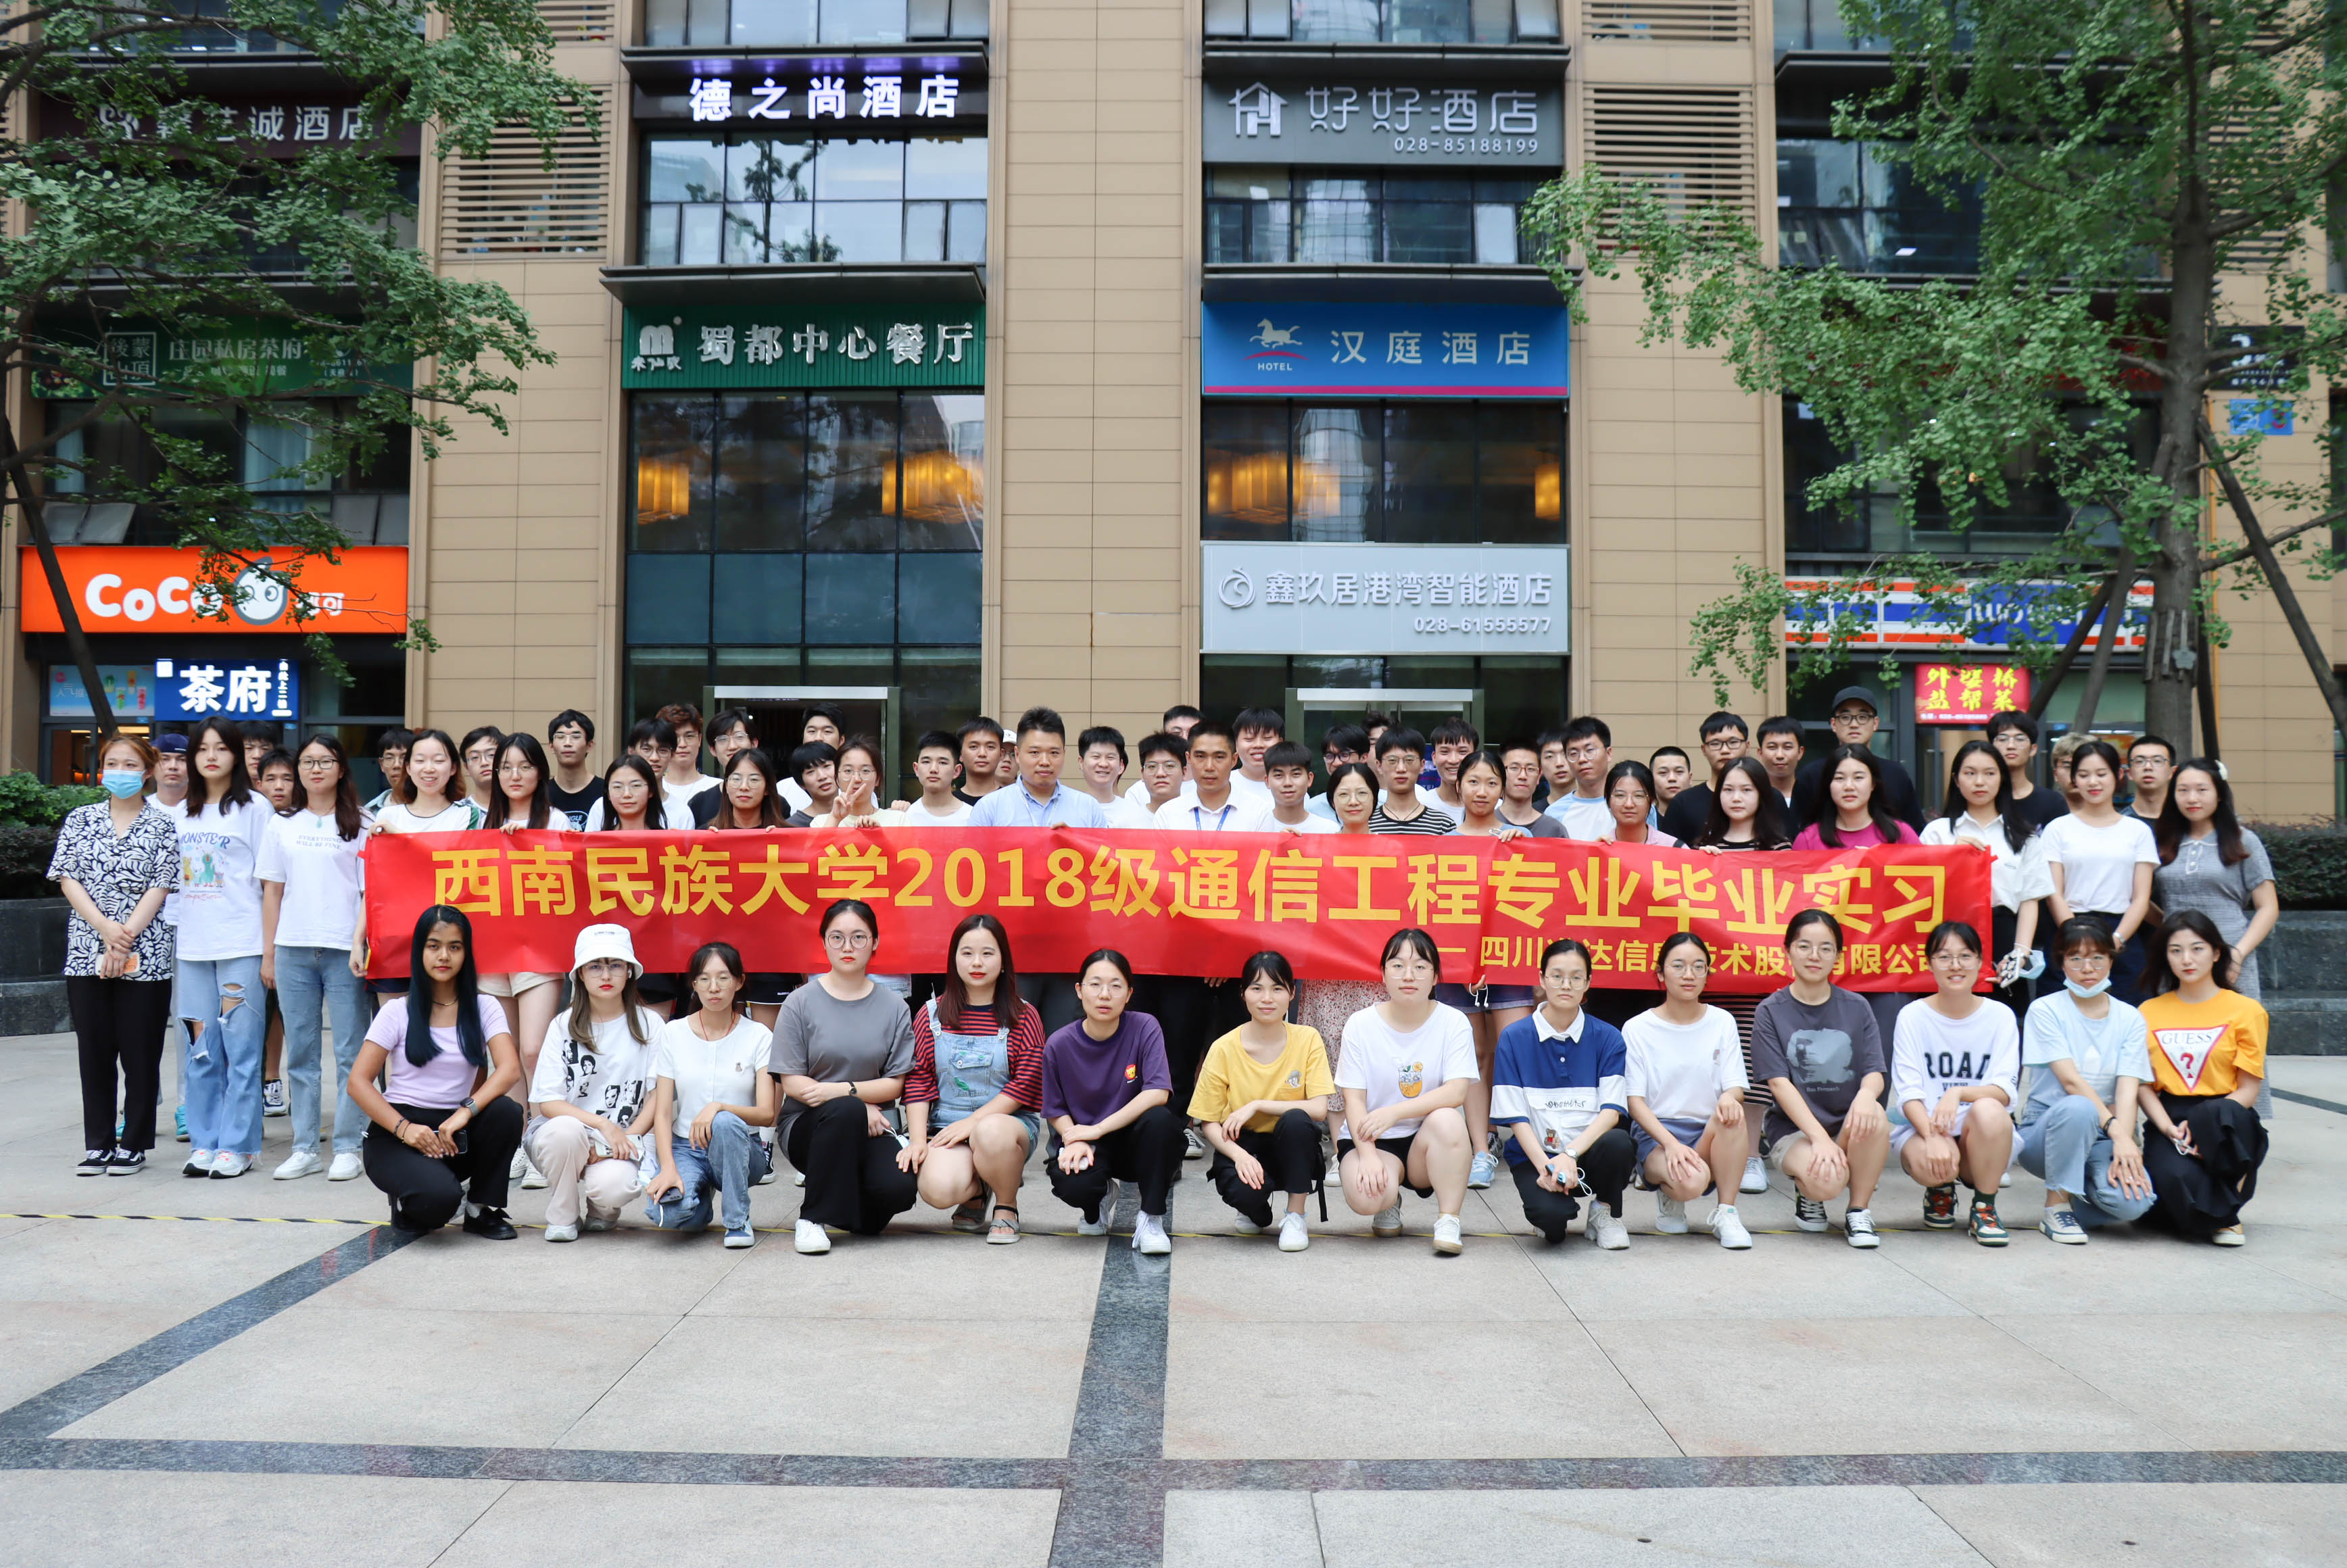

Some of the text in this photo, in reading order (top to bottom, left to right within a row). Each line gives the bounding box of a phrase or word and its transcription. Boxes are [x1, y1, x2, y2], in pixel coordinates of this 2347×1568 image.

[689, 74, 959, 122] 德之尚酒店
[1305, 86, 1537, 134] 好好酒店
[1395, 137, 1539, 154] 028-85188199
[697, 322, 973, 365] 蜀都中心餐厅
[1330, 330, 1530, 365] 汉庭酒店
[1257, 362, 1292, 370] HOTEL
[1265, 570, 1552, 606] 鑫玖居港湾智能酒店
[1414, 616, 1551, 633] 028-61555577
[179, 665, 271, 713] 茶府
[433, 843, 1945, 933] 西南民族大学2018级通信工程专业毕业实习
[2162, 1032, 2212, 1044] GUESS
